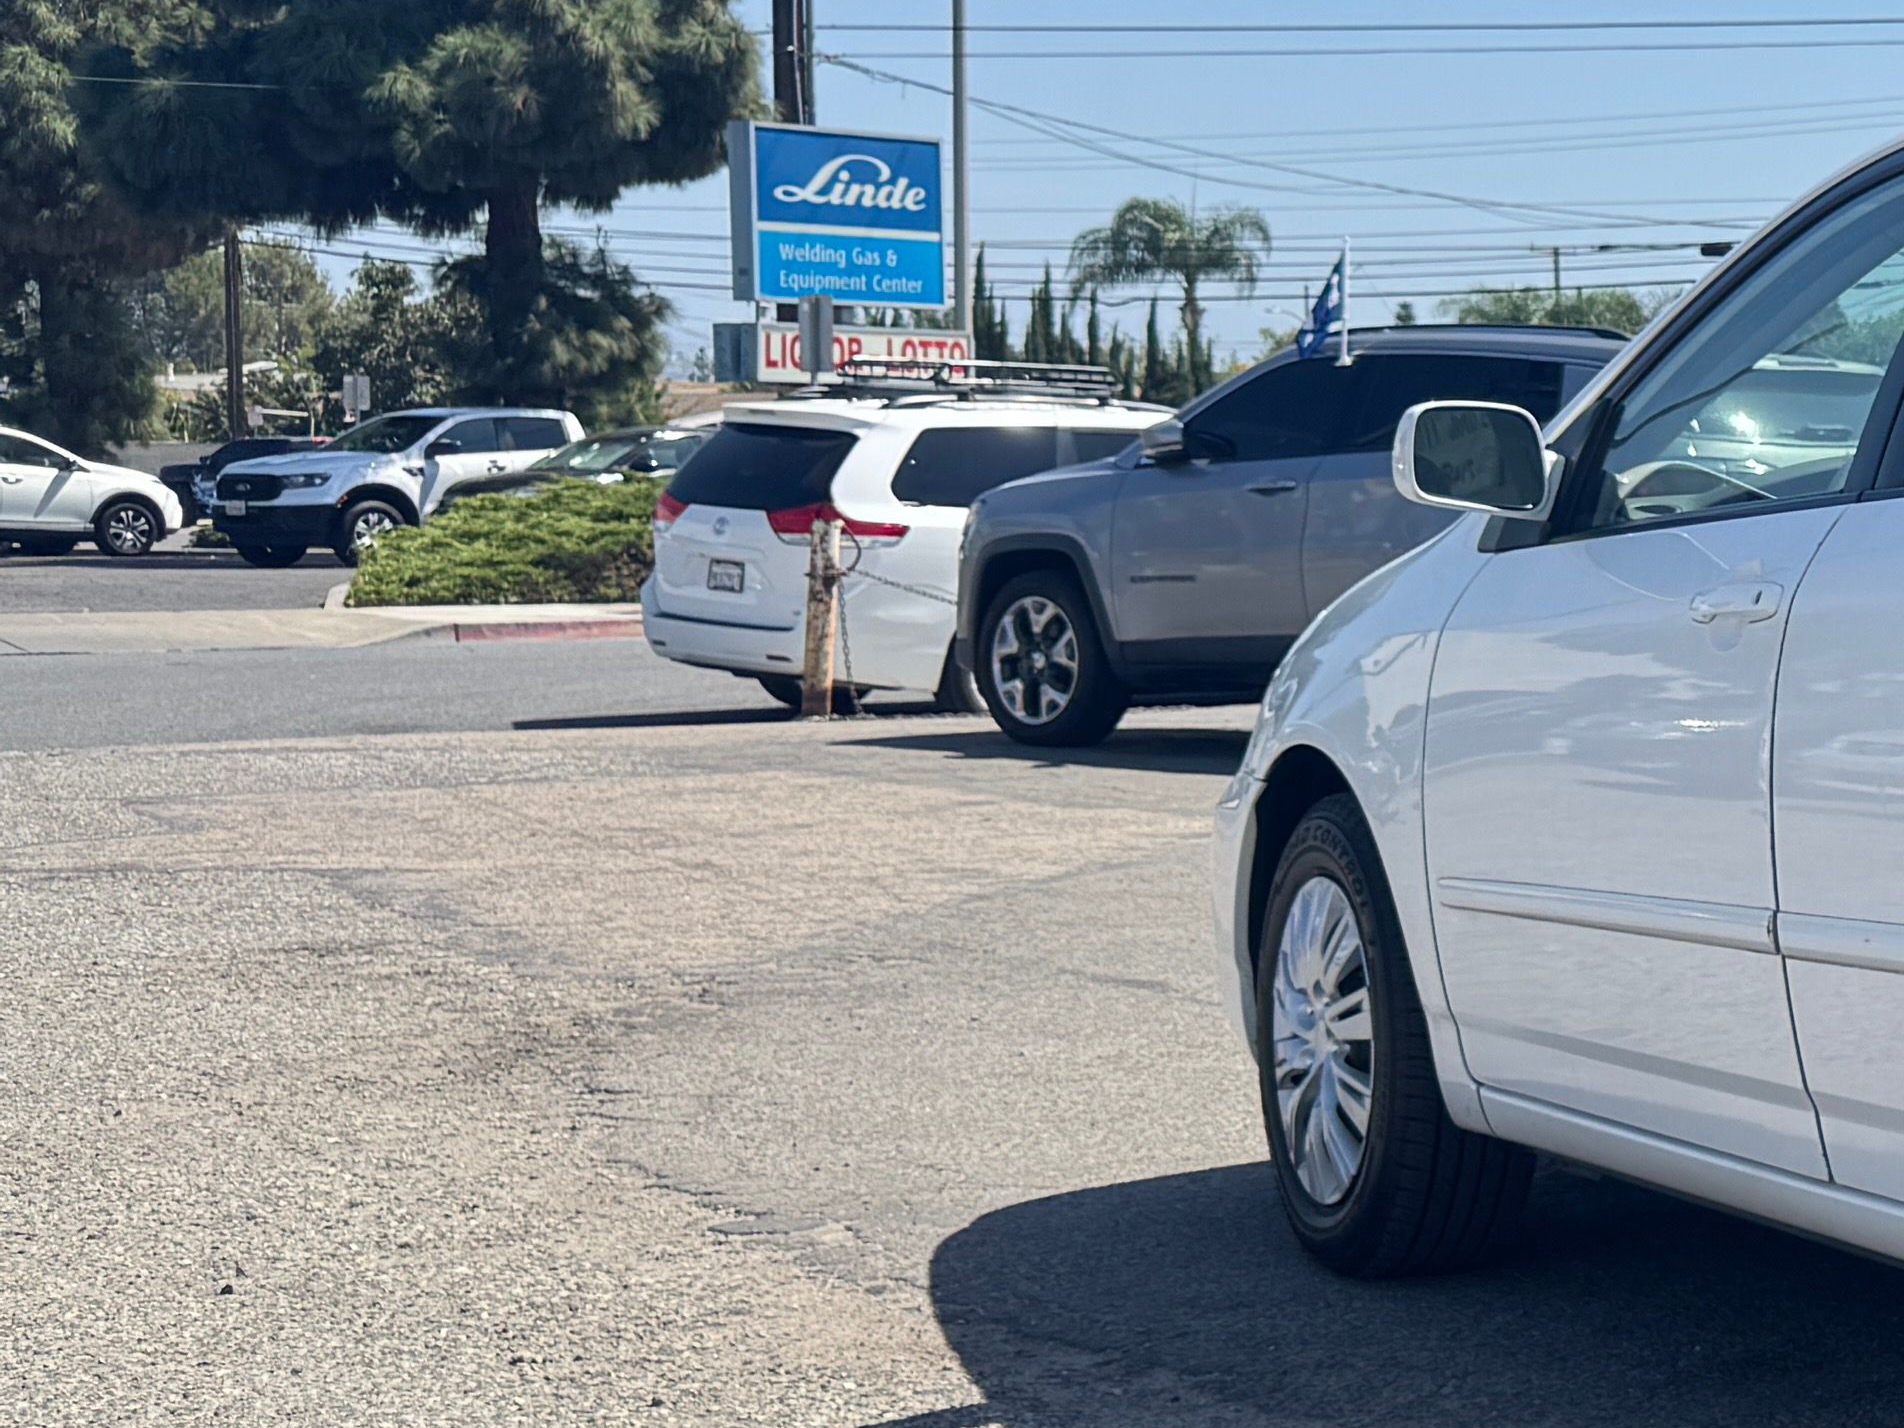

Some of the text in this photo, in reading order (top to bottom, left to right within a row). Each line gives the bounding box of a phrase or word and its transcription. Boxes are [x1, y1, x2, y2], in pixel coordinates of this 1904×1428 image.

[773, 154, 927, 211] Linde
[779, 243, 897, 268] Welding Gas &
[780, 270, 923, 294] Equipment Center
